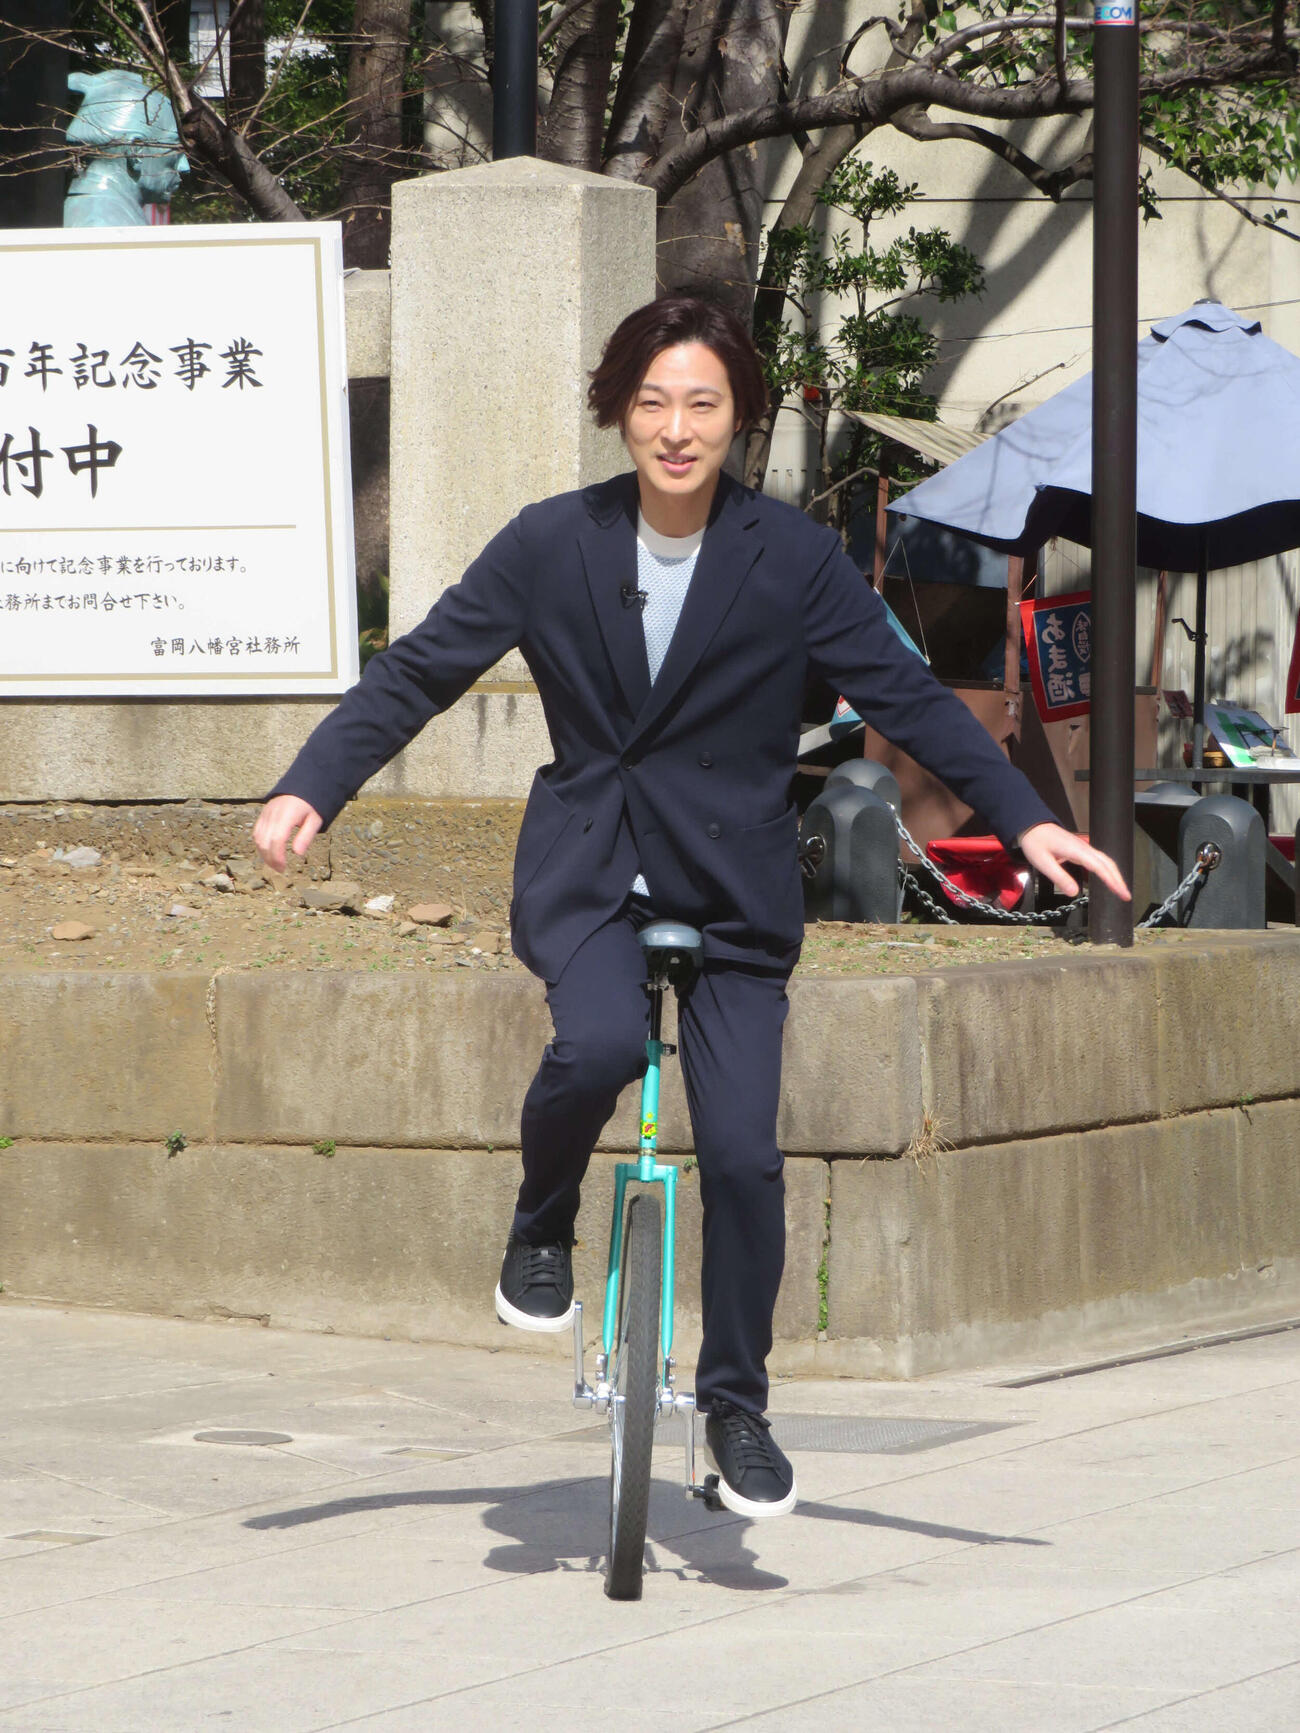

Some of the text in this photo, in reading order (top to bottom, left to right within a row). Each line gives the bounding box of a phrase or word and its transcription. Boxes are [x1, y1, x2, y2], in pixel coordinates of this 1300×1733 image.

[0, 423, 123, 500] 付中
[0, 555, 247, 575] に向けて記念事業を行っております。
[0, 591, 185, 611] 務所までお問合せ下さい。
[150, 635, 301, 656] 富岡八幡宮社務所
